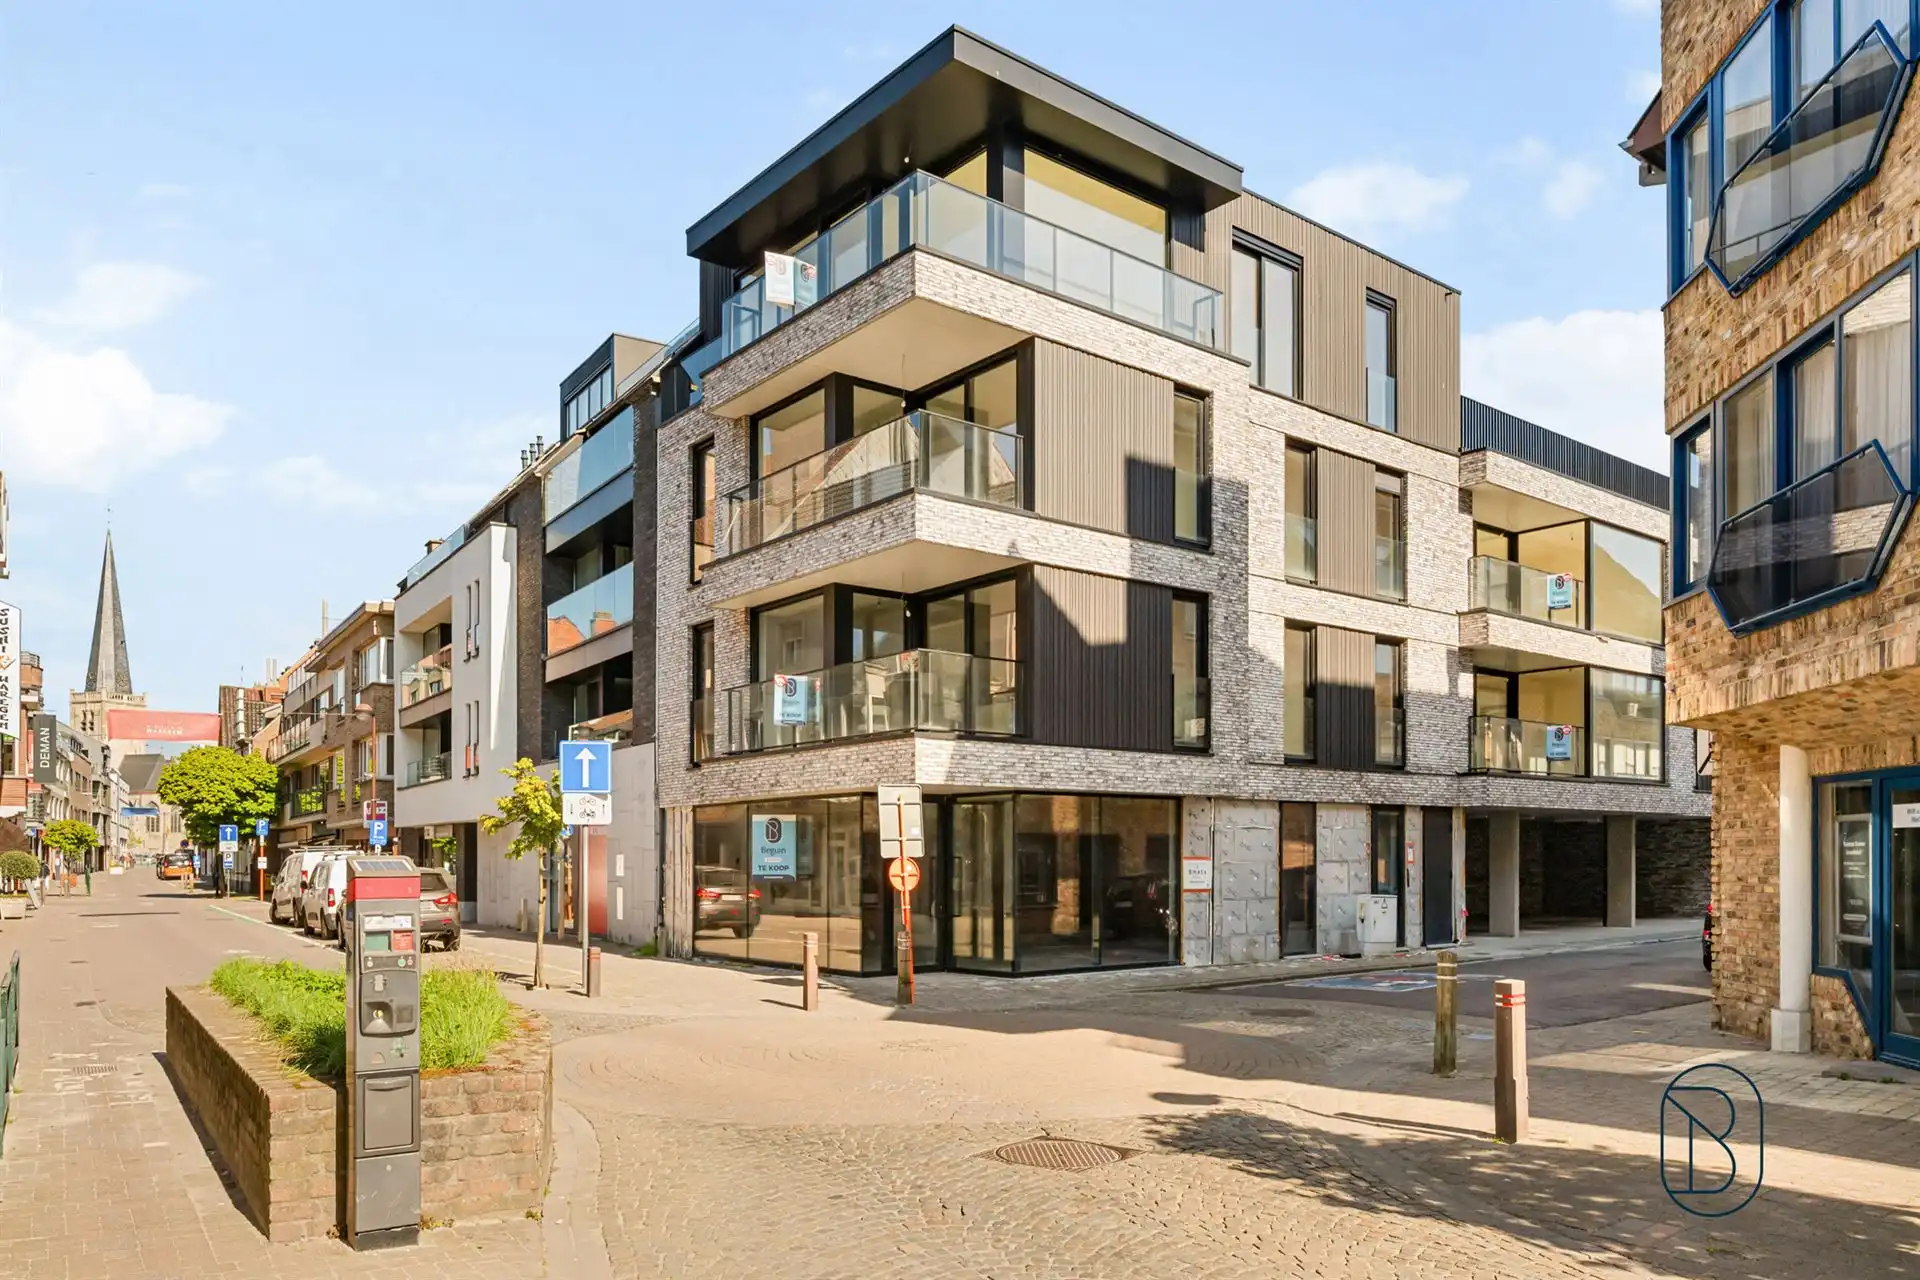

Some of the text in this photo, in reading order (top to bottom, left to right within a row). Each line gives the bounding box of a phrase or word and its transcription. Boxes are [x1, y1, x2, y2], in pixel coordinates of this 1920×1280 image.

[0, 608, 9, 653] SUSHI
[0, 676, 11, 730] WAREGEM
[40, 727, 50, 768] DEMAN
[259, 820, 265, 830] P
[374, 822, 384, 835] P
[761, 846, 787, 857] Beguin
